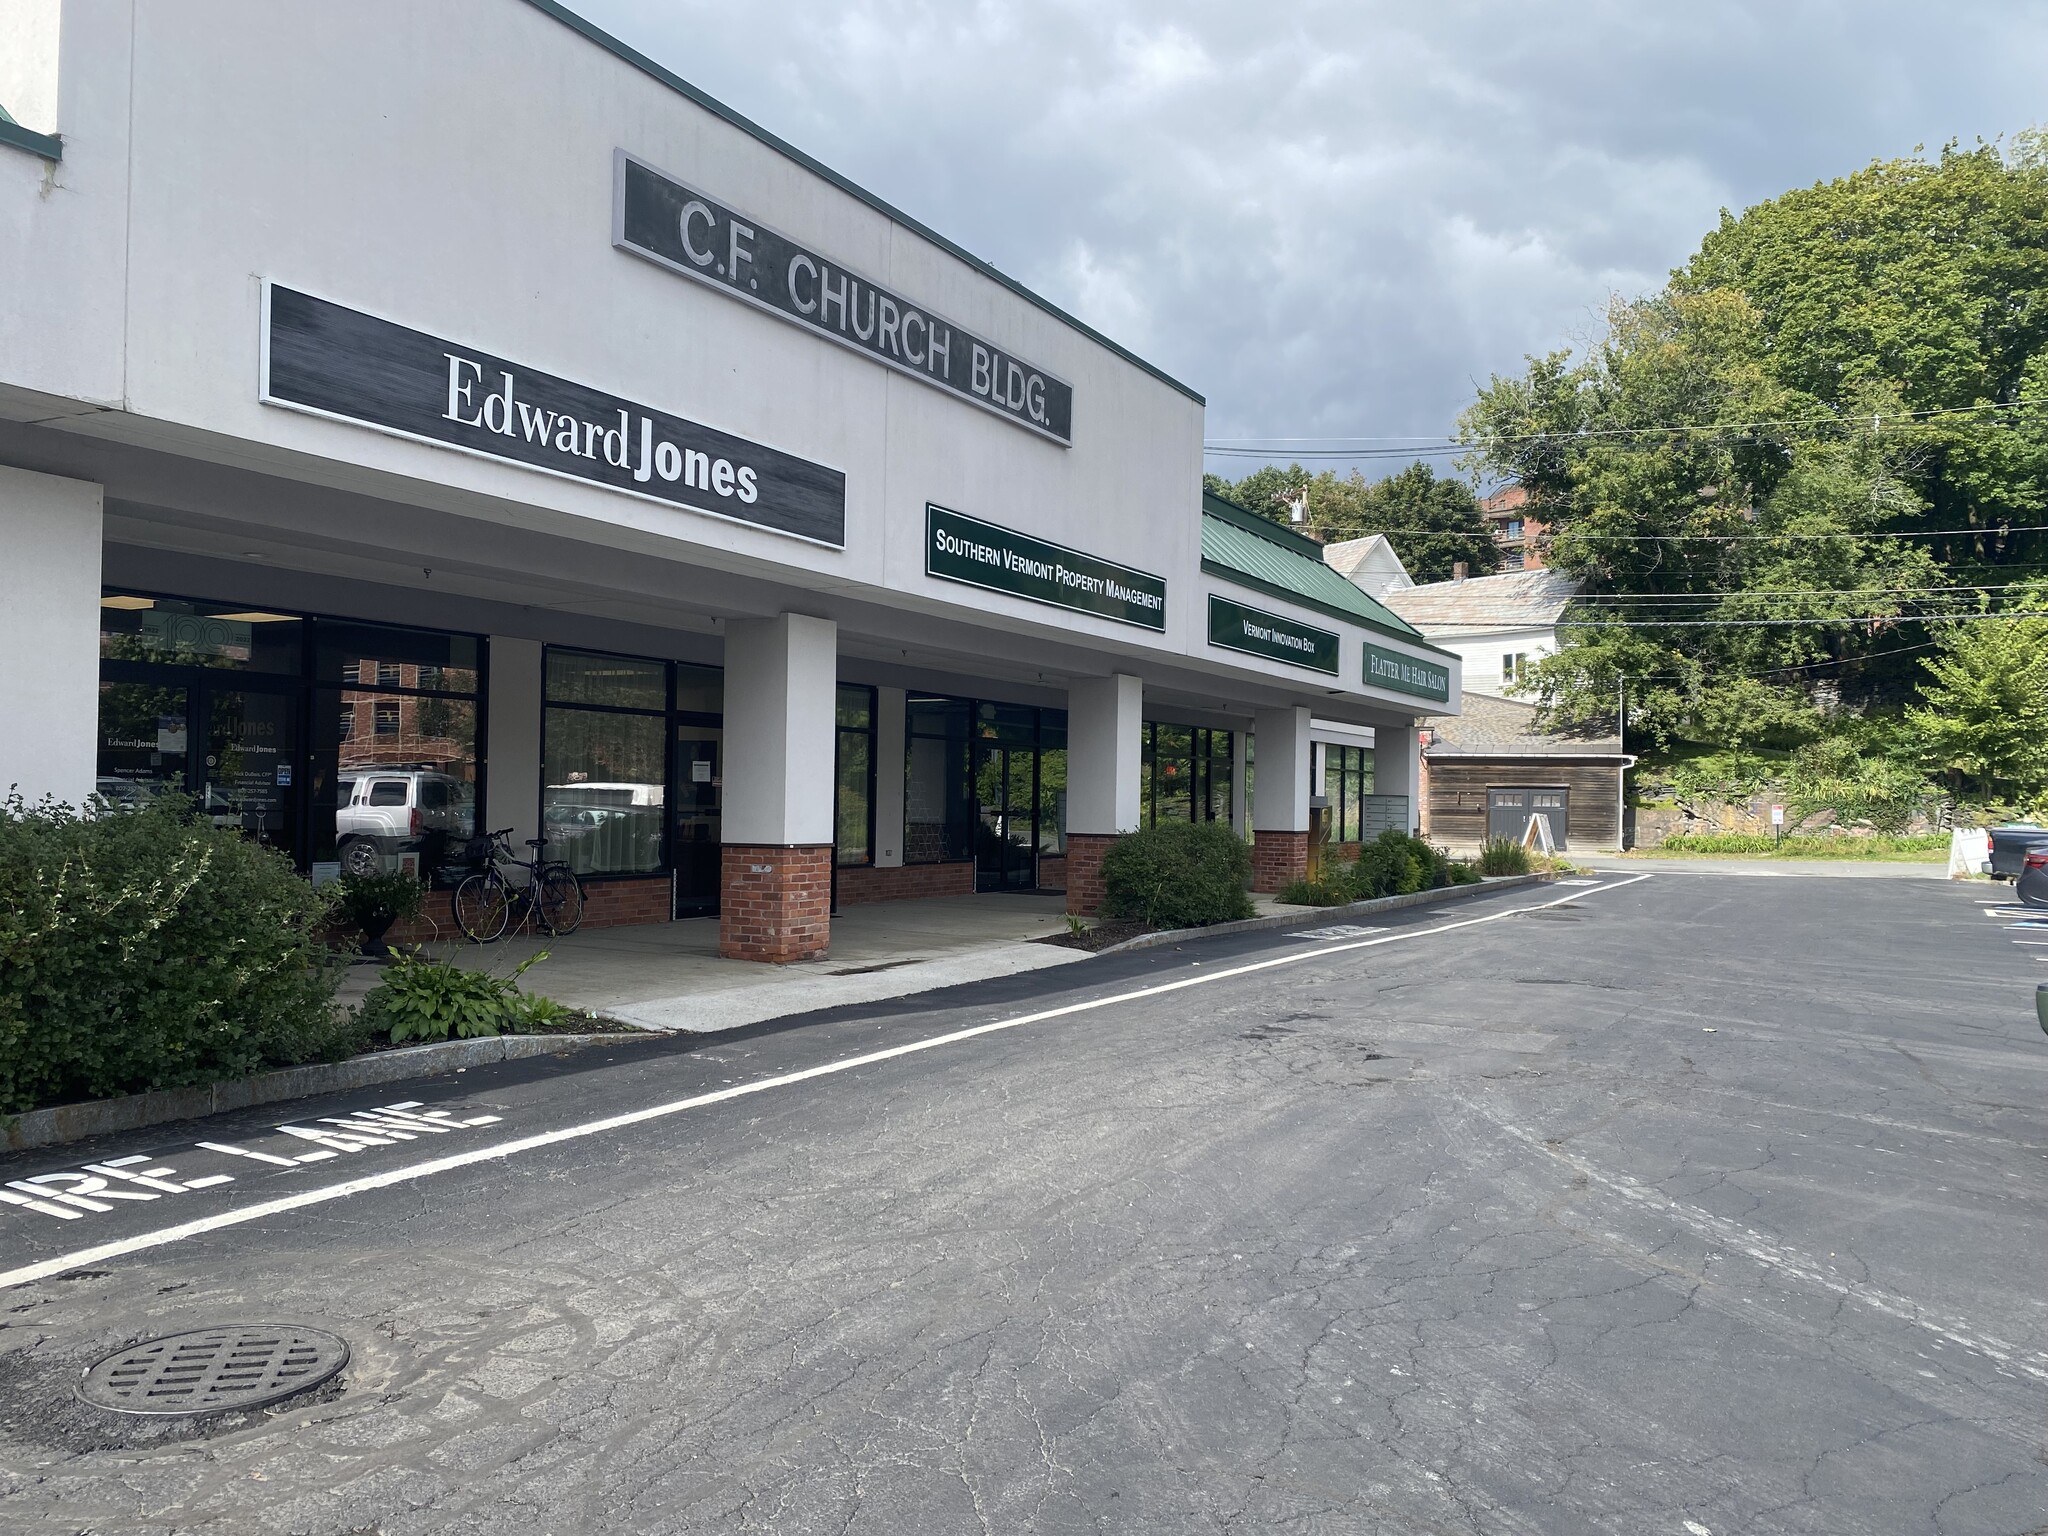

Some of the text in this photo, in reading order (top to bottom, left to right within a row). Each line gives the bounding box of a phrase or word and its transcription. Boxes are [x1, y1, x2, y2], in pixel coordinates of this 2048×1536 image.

[679, 200, 1051, 426] C.F. CHURCH BLDG.
[935, 528, 1163, 611] SOUTHERN VERMONT PROPERTY MANAGEMENT
[1243, 619, 1315, 654] VERMONT INNOVATION BOX
[1370, 654, 1446, 692] FLATTER ME HAIR SALON
[194, 1100, 504, 1167] LANE
